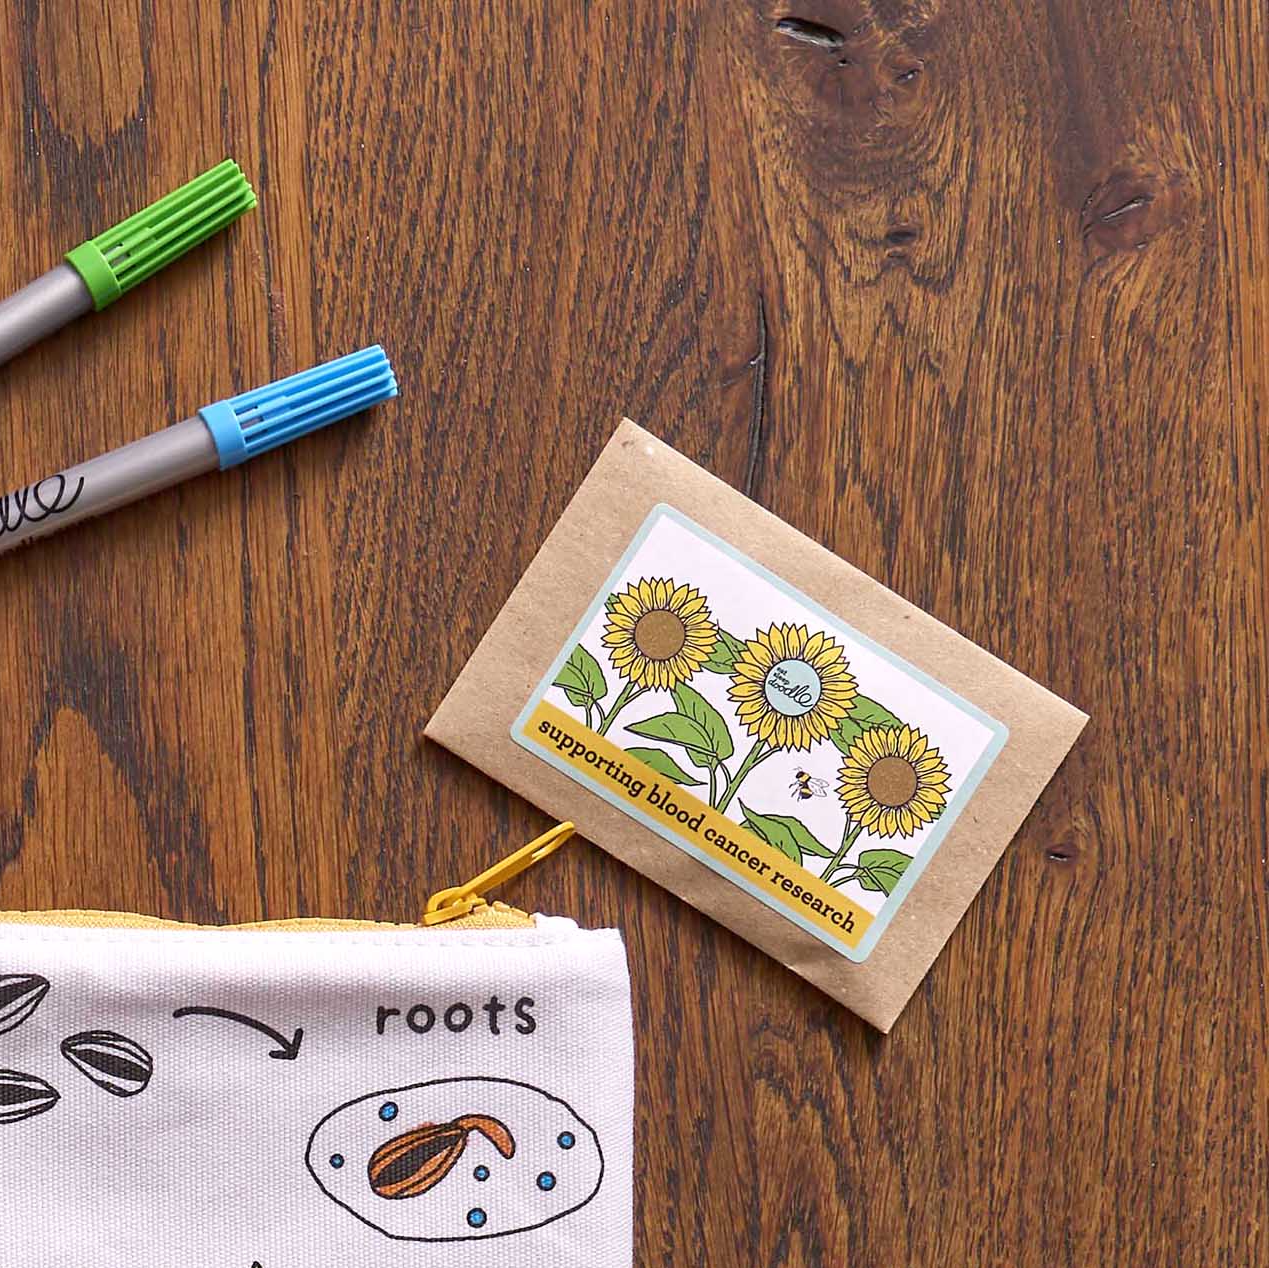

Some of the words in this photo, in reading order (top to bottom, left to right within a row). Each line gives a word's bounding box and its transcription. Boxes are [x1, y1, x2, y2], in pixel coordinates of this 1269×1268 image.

[768, 679, 813, 707] doodle
[538, 720, 646, 798] supporting
[646, 784, 706, 832] blood
[704, 828, 771, 876] cancer
[770, 871, 856, 934] research
[375, 995, 537, 1036] roots
